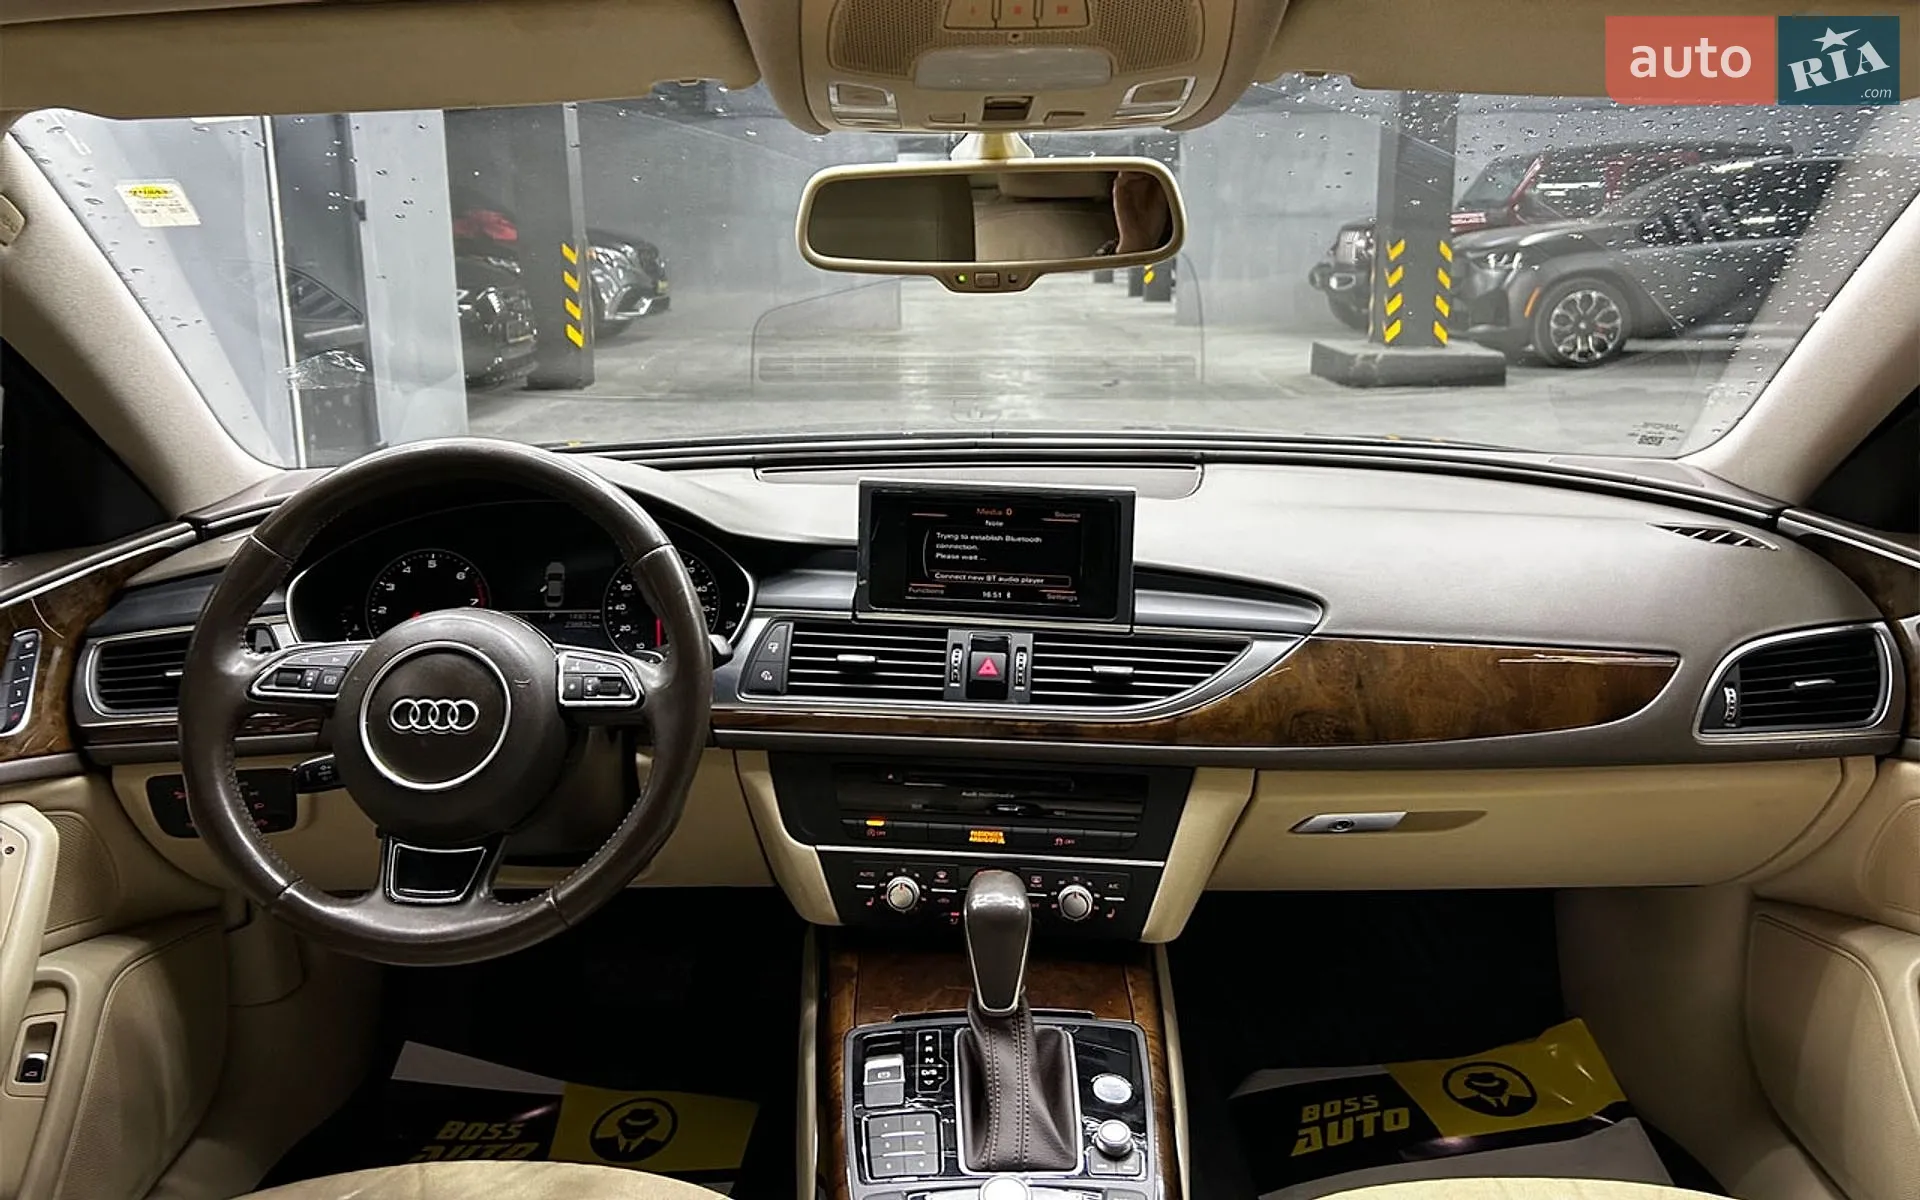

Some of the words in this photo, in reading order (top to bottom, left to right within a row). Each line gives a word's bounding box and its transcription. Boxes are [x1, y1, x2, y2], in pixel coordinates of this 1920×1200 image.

[976, 508, 1003, 516] Media
[1054, 511, 1081, 519] Source
[985, 519, 1004, 527] Note
[936, 532, 959, 541] Trying
[1005, 535, 1043, 543] Bluetooth
[935, 552, 960, 560] Please
[427, 559, 438, 568] 5
[402, 566, 412, 574] 4
[456, 571, 466, 580] 6
[934, 572, 966, 580] Connect
[986, 574, 997, 582] BT
[1021, 577, 1045, 585] player
[385, 582, 396, 591] 3
[620, 583, 633, 591] 60
[908, 587, 945, 595] Functions
[1046, 592, 1078, 602] Settings
[470, 598, 480, 606] 7
[377, 606, 388, 614] 2
[614, 602, 627, 611] 40
[619, 624, 631, 632] 20
[1301, 1095, 1379, 1123] BOSS
[436, 1120, 525, 1140] BOSS
[1290, 1107, 1410, 1157] AUTO
